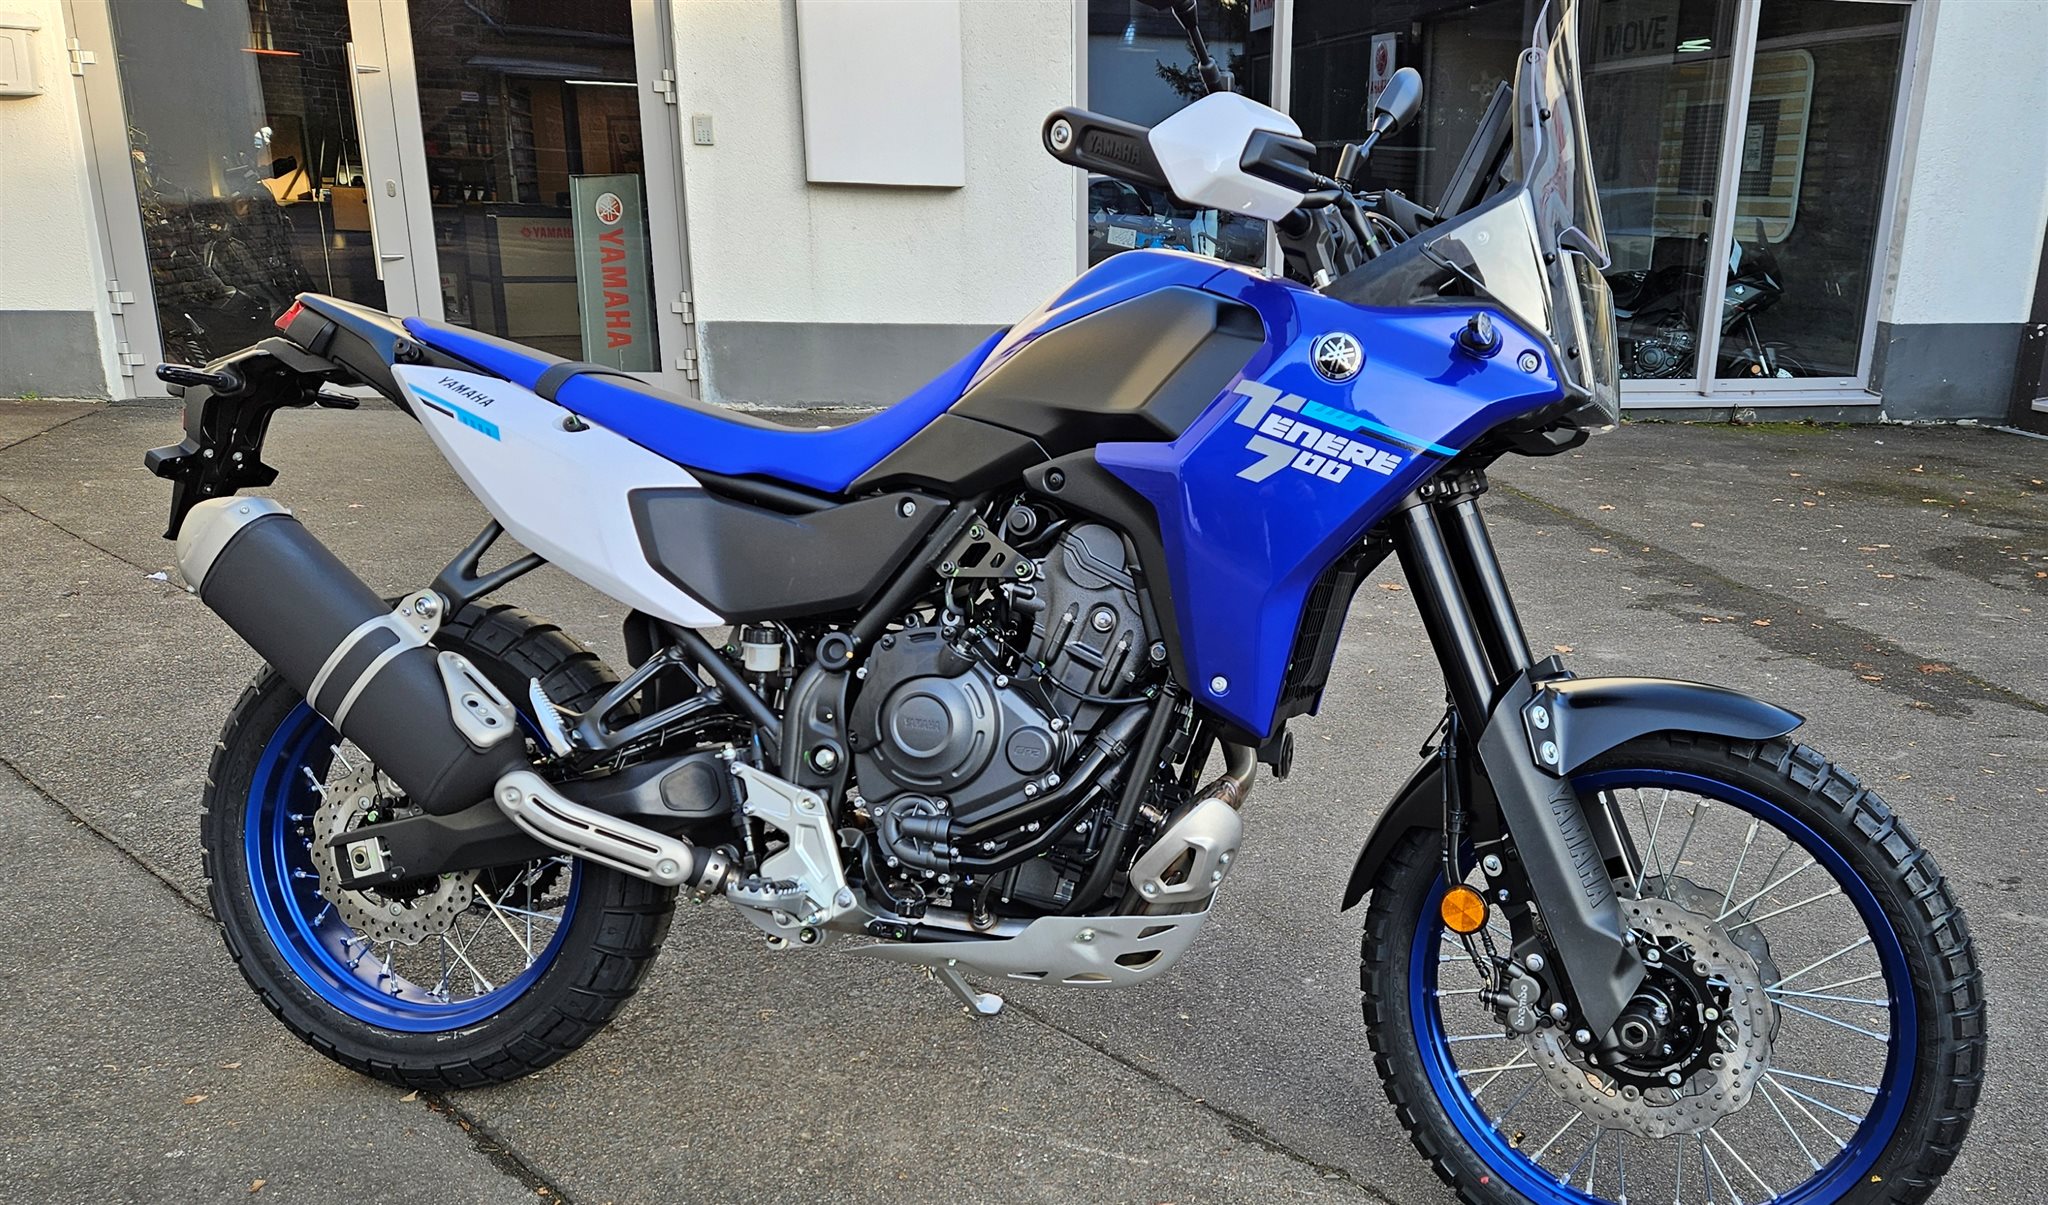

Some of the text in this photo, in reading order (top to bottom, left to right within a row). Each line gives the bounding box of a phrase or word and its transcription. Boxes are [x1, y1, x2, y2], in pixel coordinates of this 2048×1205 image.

[1603, 16, 1669, 56] MOVE
[1090, 135, 1140, 165] YAMAHA
[533, 226, 573, 239] YAMAH
[599, 228, 632, 348] YAMAHA
[438, 376, 495, 407] YAMAHA
[1235, 434, 1352, 483] 700
[1548, 784, 1611, 909] YAMAHA
[1515, 984, 1528, 1027] brembo
